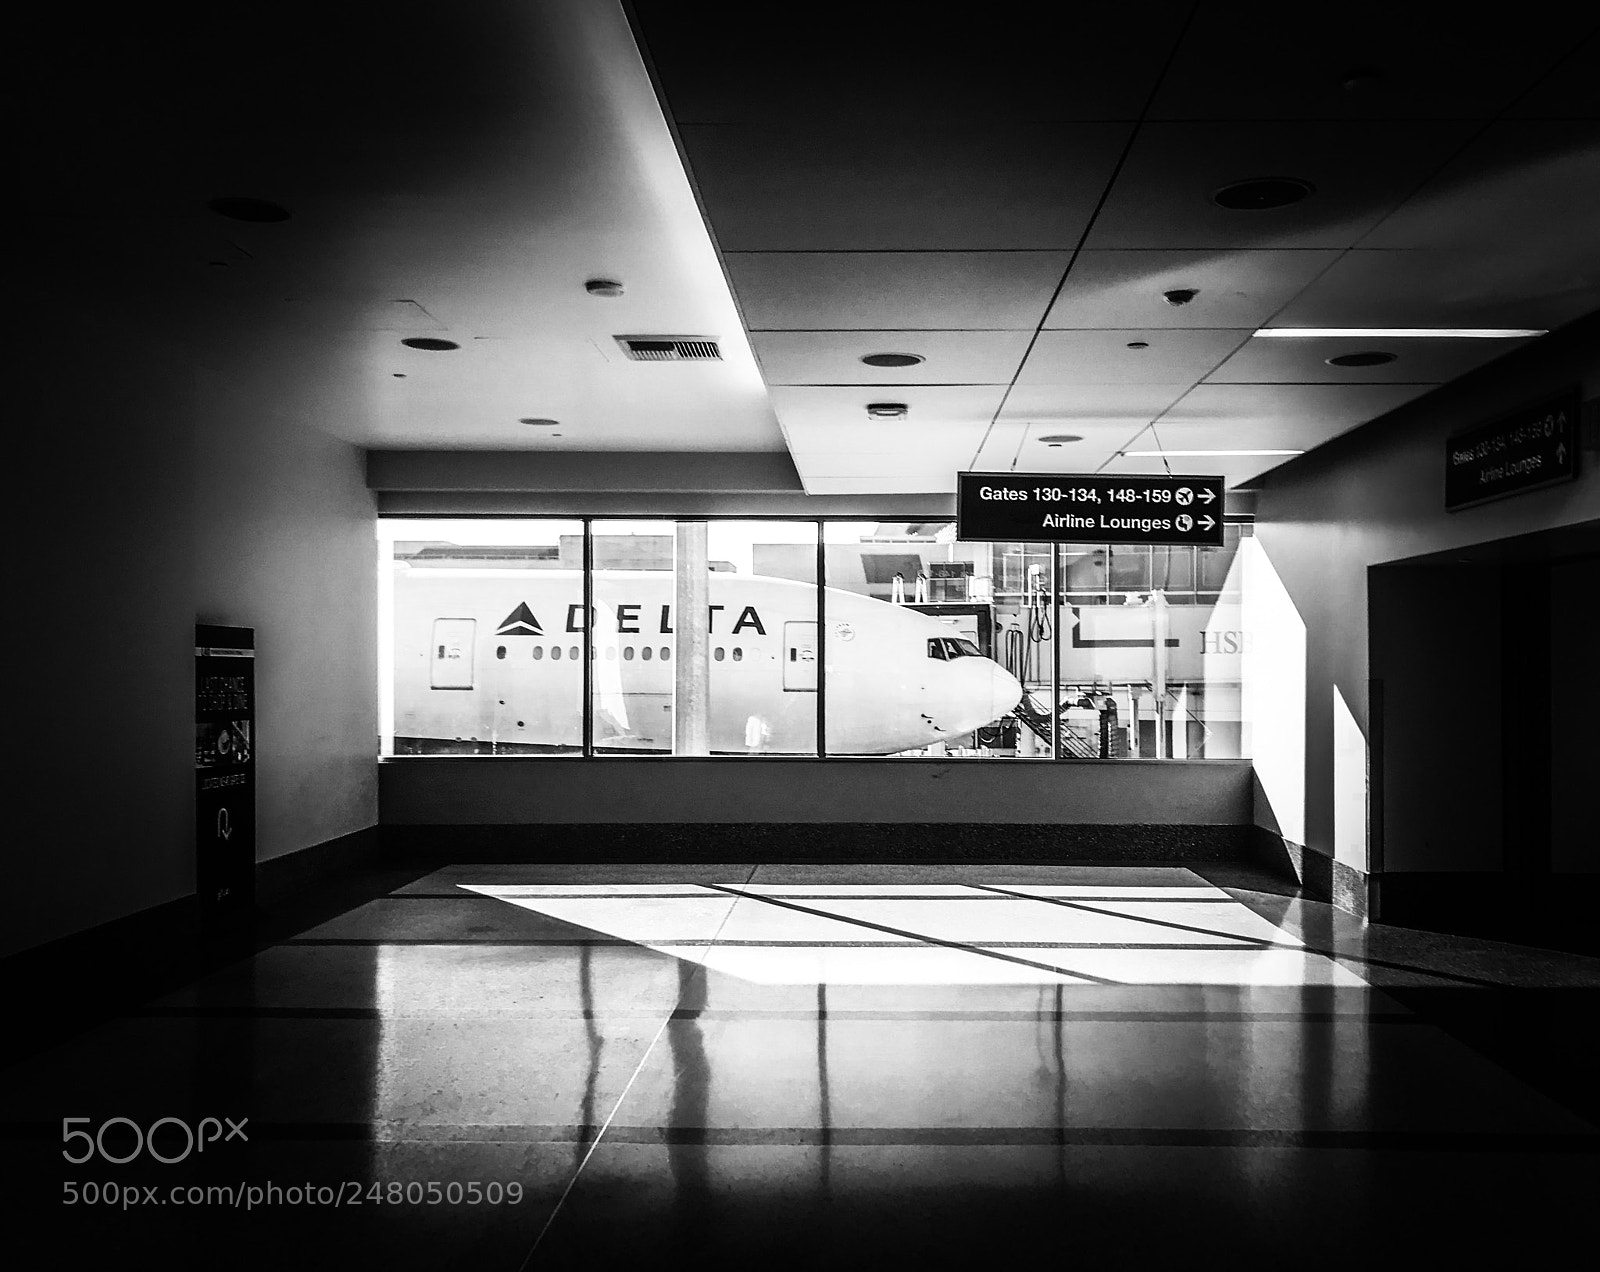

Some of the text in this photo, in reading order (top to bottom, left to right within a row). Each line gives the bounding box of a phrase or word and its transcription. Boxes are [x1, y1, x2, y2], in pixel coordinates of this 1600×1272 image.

[1505, 453, 1542, 476] Lounges
[979, 486, 1172, 505] Gates 130-134, 148-159
[1042, 513, 1171, 532] Airline Lounges
